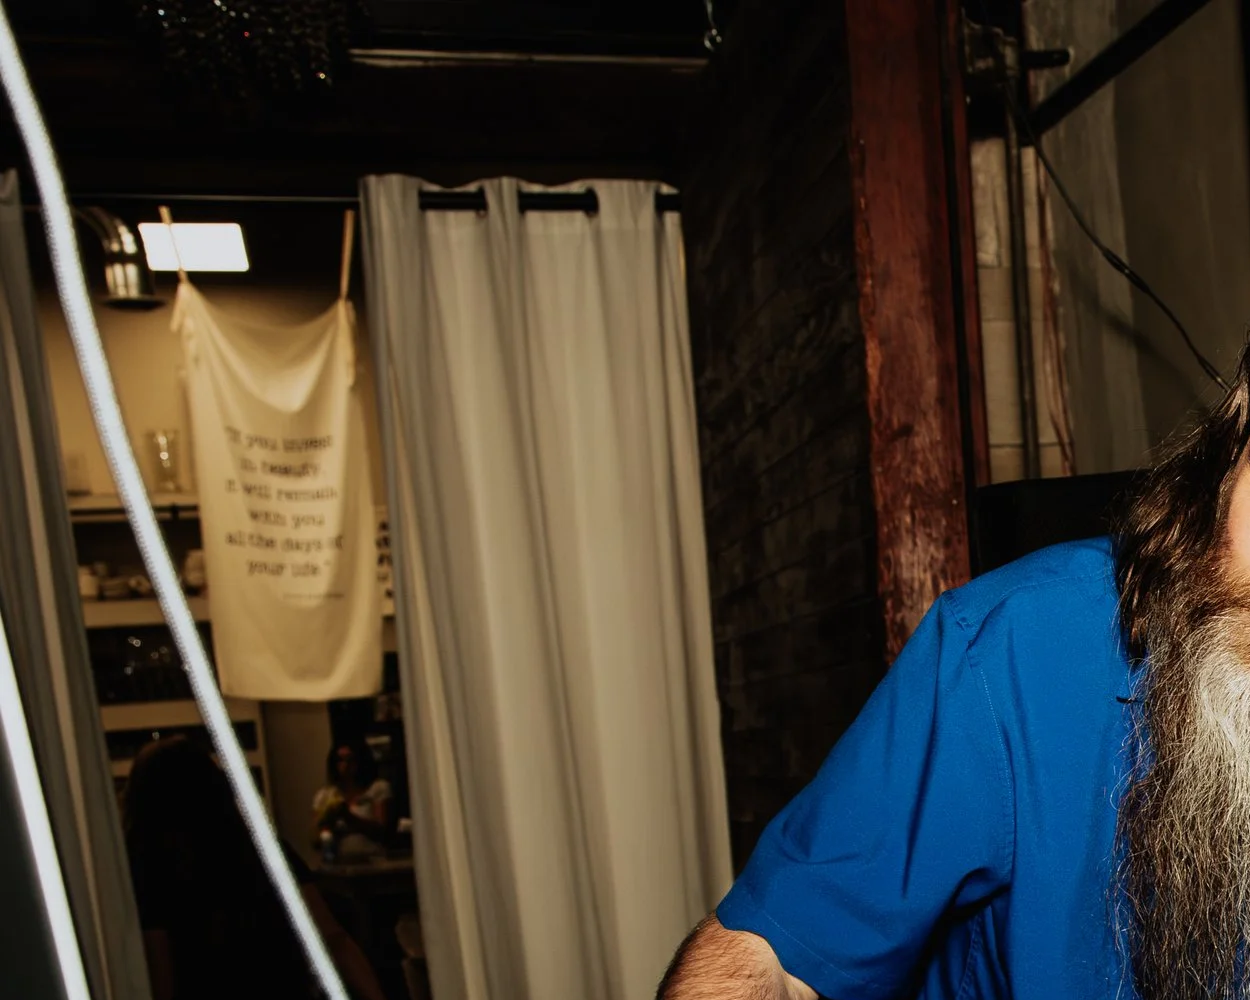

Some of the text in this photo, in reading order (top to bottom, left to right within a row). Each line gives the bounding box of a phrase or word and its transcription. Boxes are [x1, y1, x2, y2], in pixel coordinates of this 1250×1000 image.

[245, 434, 278, 451] you
[282, 435, 332, 453] invest
[241, 482, 272, 500] will
[276, 487, 338, 501] remain
[249, 509, 325, 530] with you
[224, 530, 246, 547] all
[247, 532, 276, 549] the
[281, 537, 322, 553] days
[246, 560, 284, 577] your
